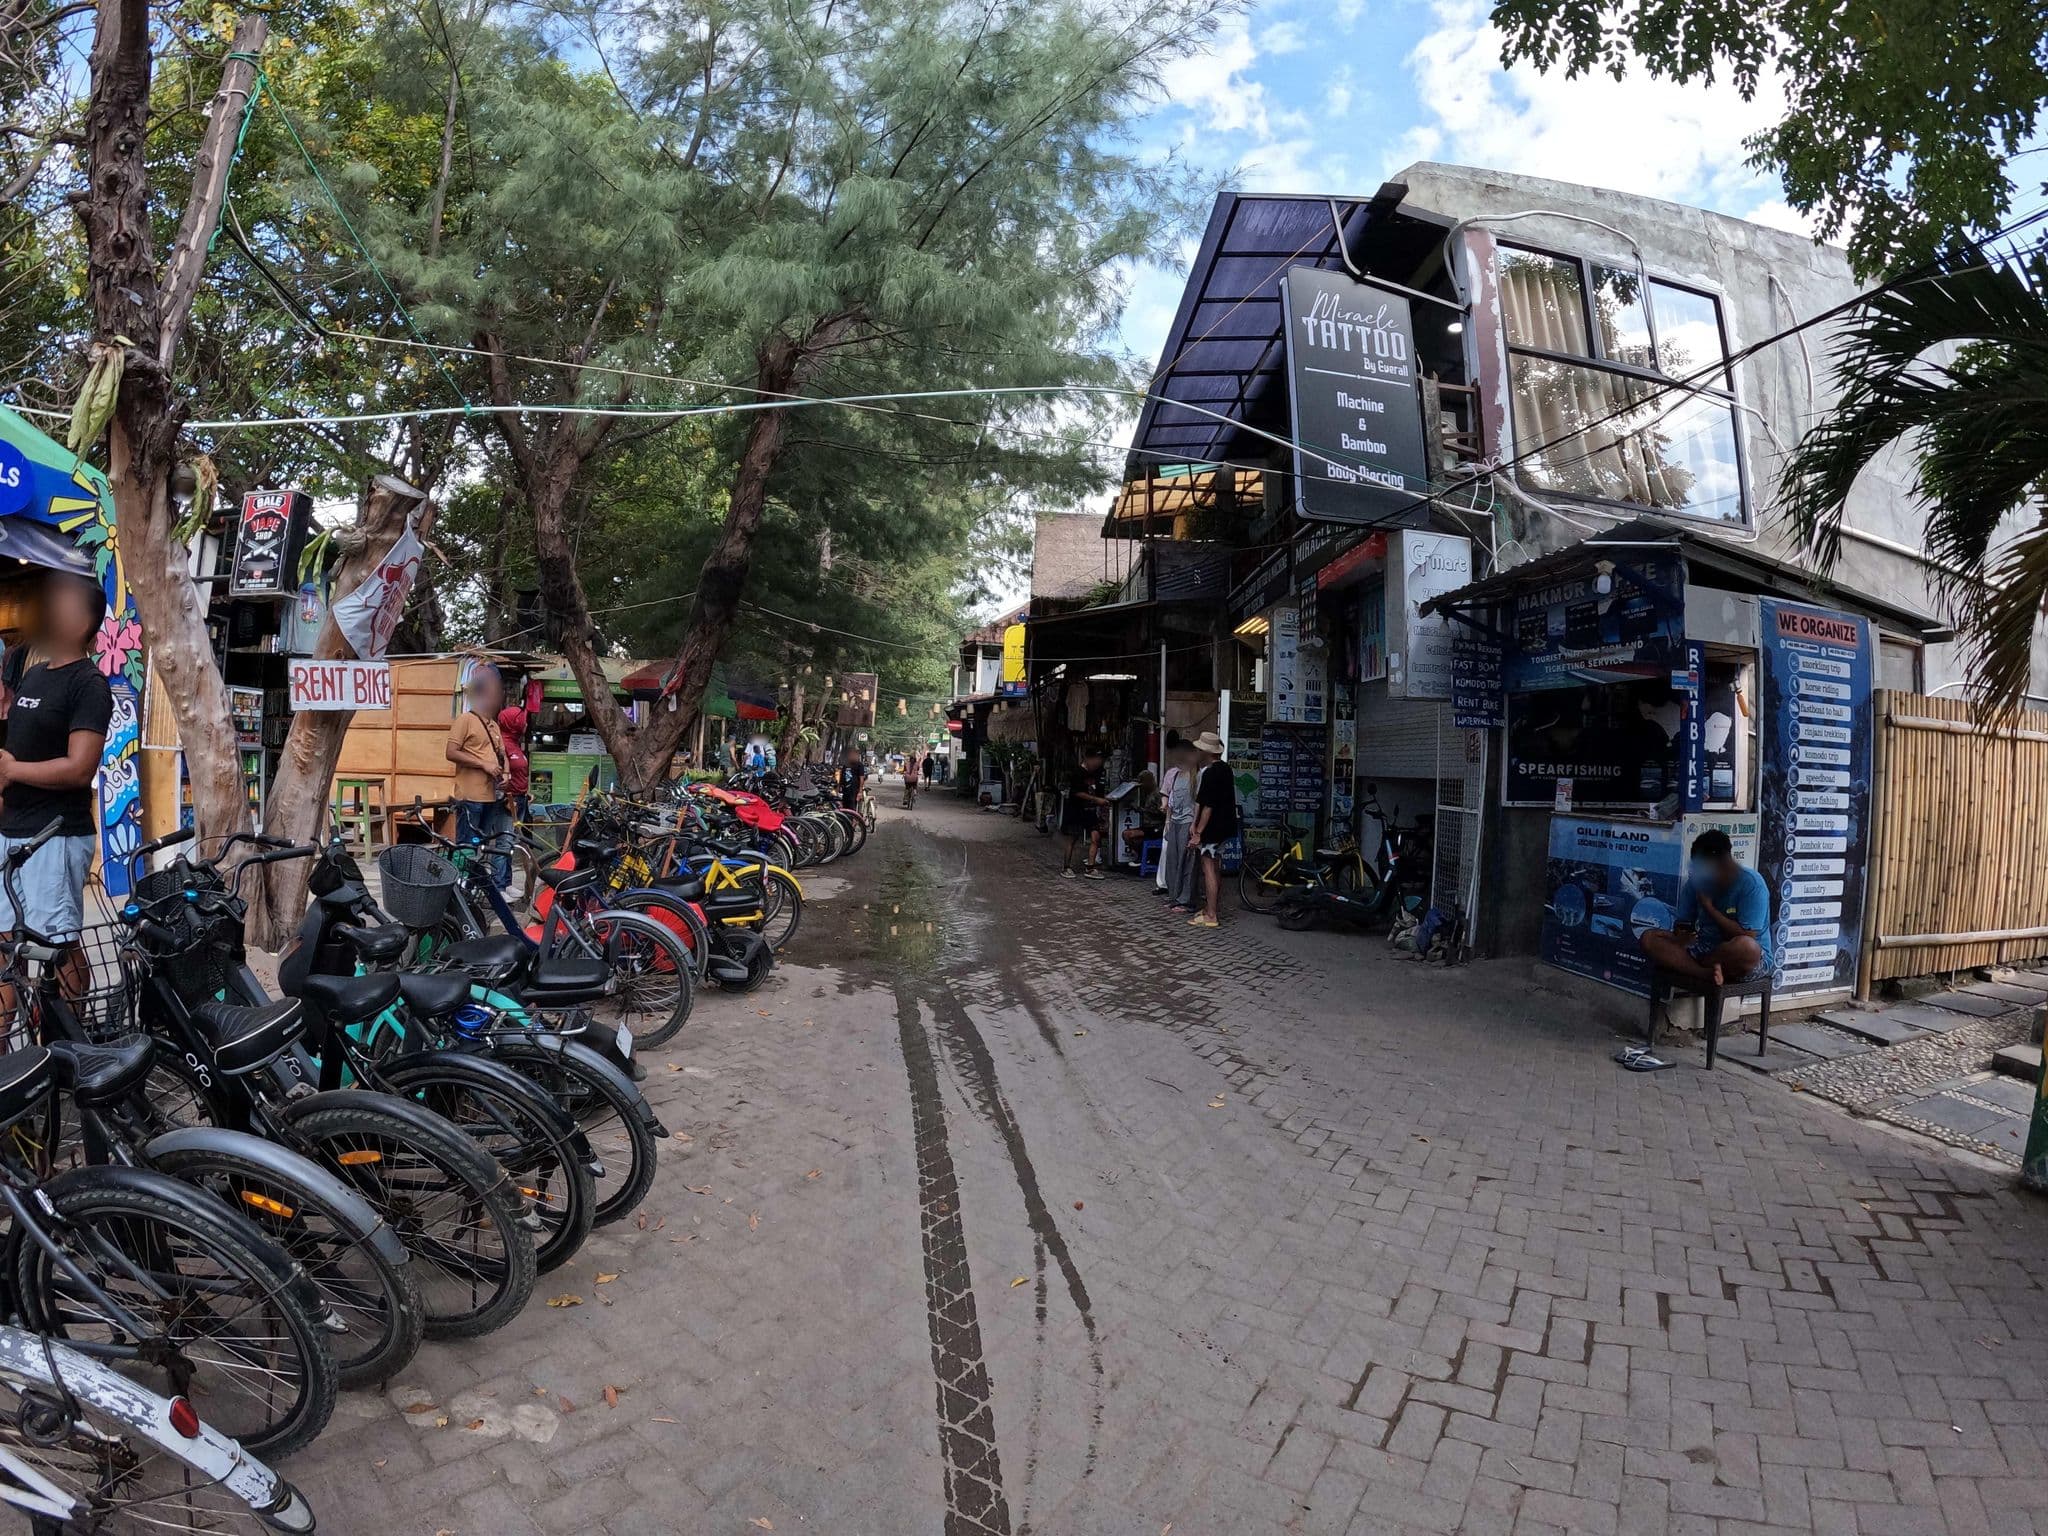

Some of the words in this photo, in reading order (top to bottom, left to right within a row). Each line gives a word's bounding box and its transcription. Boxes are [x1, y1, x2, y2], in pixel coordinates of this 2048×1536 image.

[1310, 290, 1399, 330] Miracle
[1301, 316, 1407, 361] TATTOO
[1363, 357, 1376, 374] By
[1336, 391, 1384, 413] Machine
[1358, 418, 1366, 431] &
[1341, 433, 1387, 454] Bamboo
[256, 495, 283, 508] BALE
[1779, 612, 1797, 633] WE
[1800, 617, 1856, 642] ORGANIZE
[1454, 659, 1474, 670] FAST
[1478, 661, 1500, 672] BOAT
[1588, 655, 1625, 668] SERVICE
[294, 666, 347, 702] RENT
[353, 668, 390, 705] BIKE
[1458, 696, 1479, 707] RENT
[1518, 763, 1622, 777] SPEARFISHING
[1600, 829, 1650, 842] ISLAND
